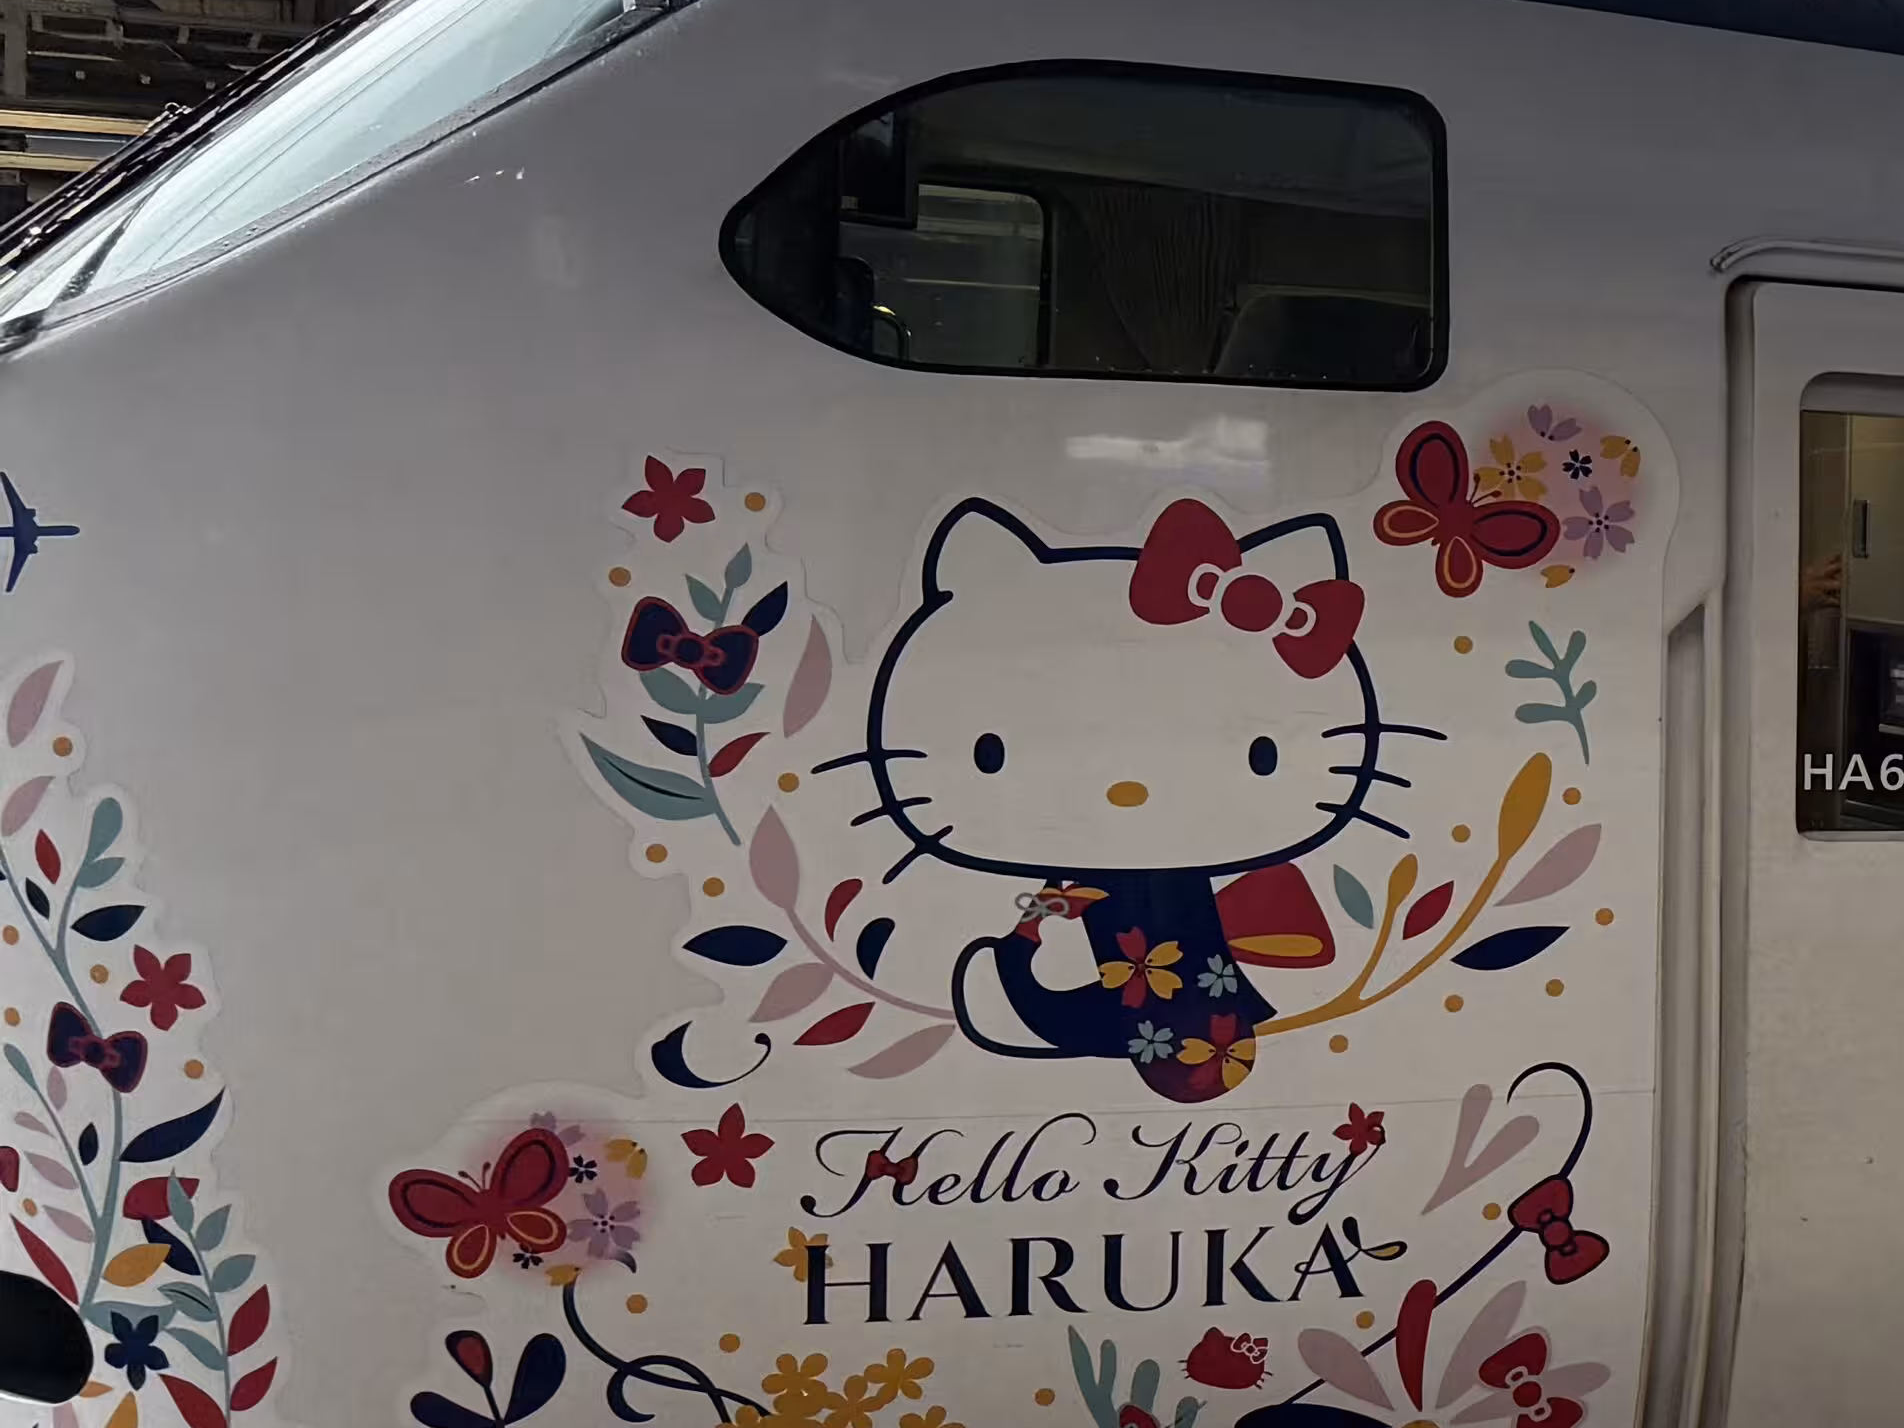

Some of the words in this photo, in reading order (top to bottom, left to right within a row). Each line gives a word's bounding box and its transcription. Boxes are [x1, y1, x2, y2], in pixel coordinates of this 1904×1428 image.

[800, 1112, 1097, 1218] Hello
[1102, 1120, 1387, 1225] Kitty
[803, 1220, 1395, 1325] HARUKA
